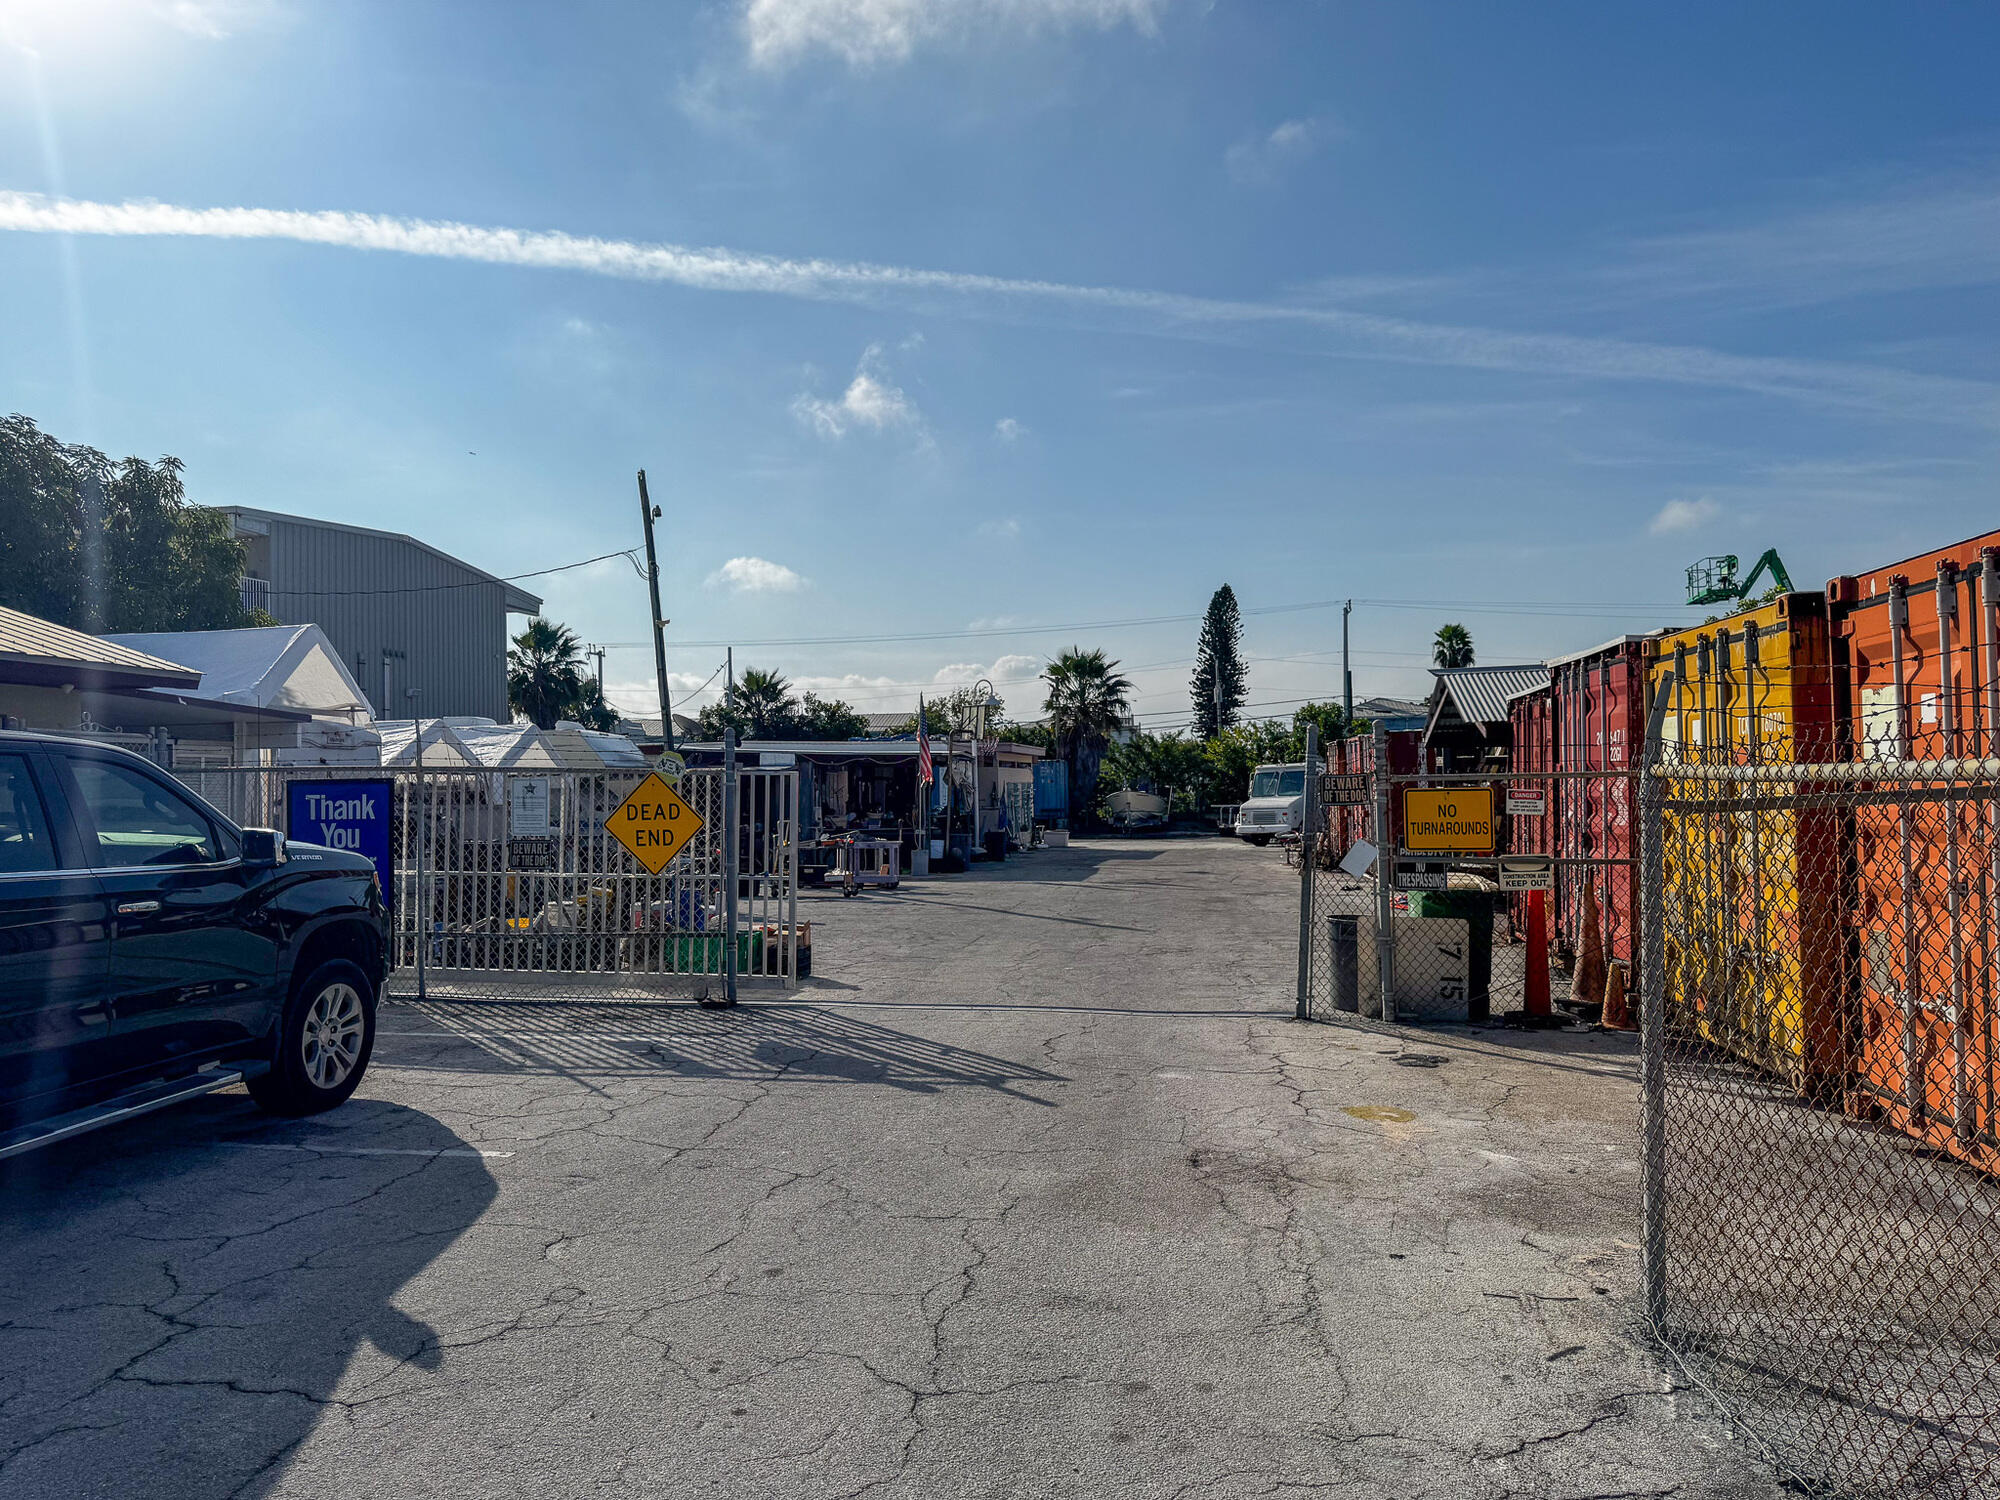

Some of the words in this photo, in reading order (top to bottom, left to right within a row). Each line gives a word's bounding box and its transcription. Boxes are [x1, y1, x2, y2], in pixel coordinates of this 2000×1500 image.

[1324, 776, 1365, 790] BEWARE
[1323, 790, 1334, 802] OF
[1335, 790, 1350, 802] THE
[1350, 789, 1367, 802] DOG
[1514, 791, 1537, 799] DANGER
[305, 793, 376, 820] Thank
[626, 803, 680, 821] DEAD
[1438, 804, 1457, 818] NO
[1410, 821, 1489, 836] TURNAROUNDS
[320, 823, 360, 849] You
[636, 829, 674, 847] END
[513, 843, 549, 855] BEWARE
[512, 855, 520, 866] OF
[521, 855, 534, 866] THE
[534, 855, 550, 866] DOG
[1415, 862, 1426, 873] NO
[1398, 872, 1445, 887] TRESPASSING
[1505, 879, 1528, 887] KEEP
[1530, 879, 1547, 887] OUT
